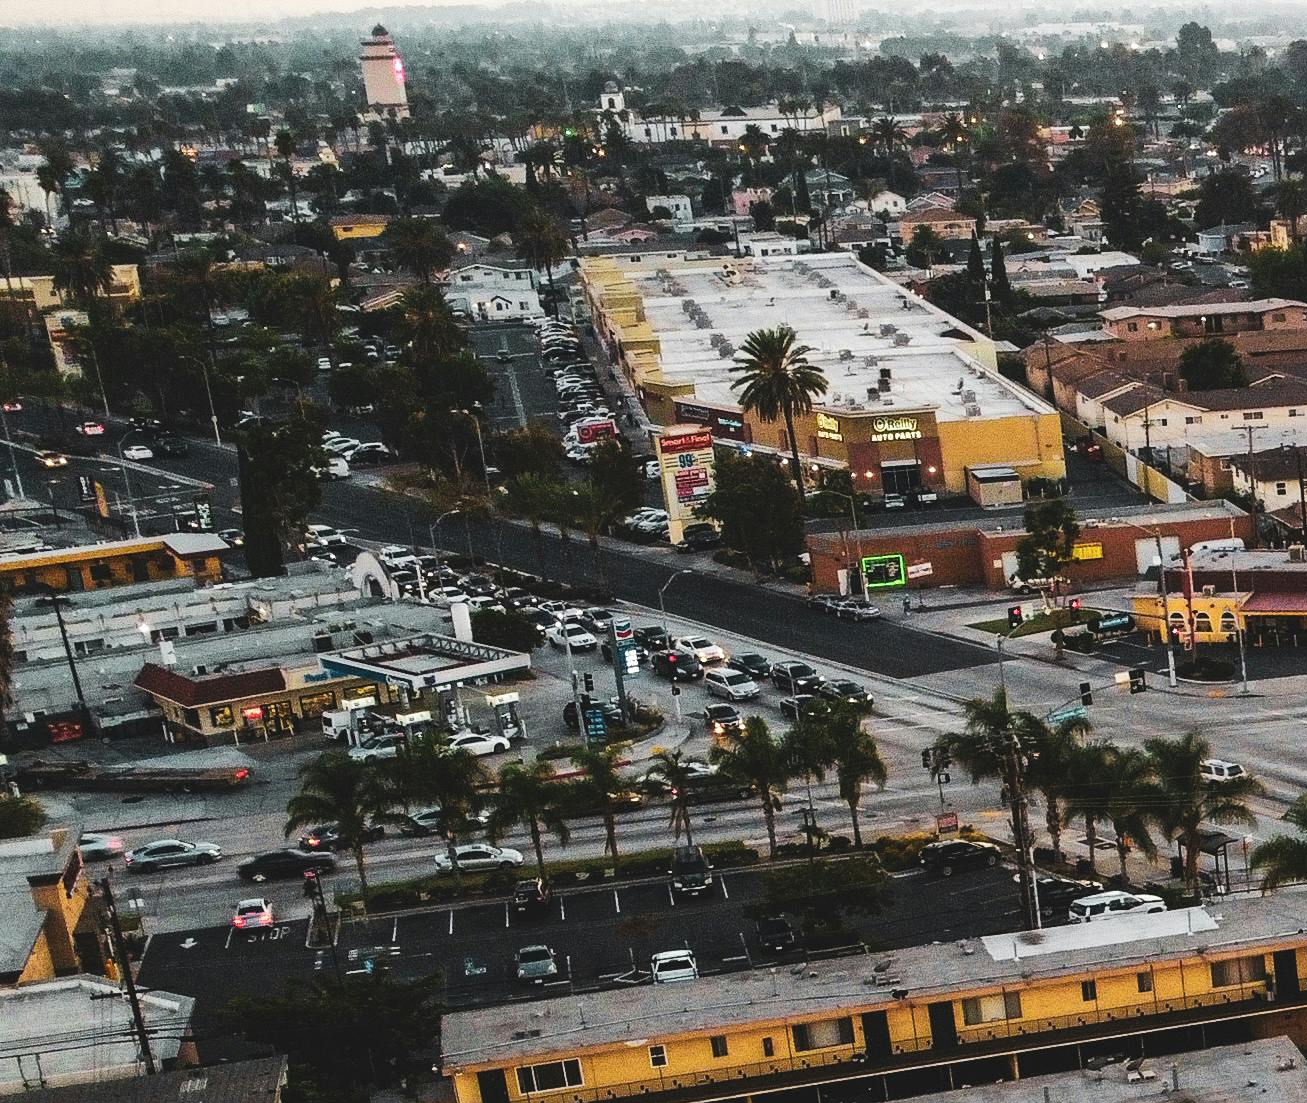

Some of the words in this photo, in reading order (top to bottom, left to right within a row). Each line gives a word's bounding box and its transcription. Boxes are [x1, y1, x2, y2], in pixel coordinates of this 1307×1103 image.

[873, 417, 917, 432] O'Reilly
[660, 437, 685, 447] Smart
[691, 433, 710, 443] Final
[871, 433, 895, 442] AUTO
[895, 431, 922, 441] PARTS
